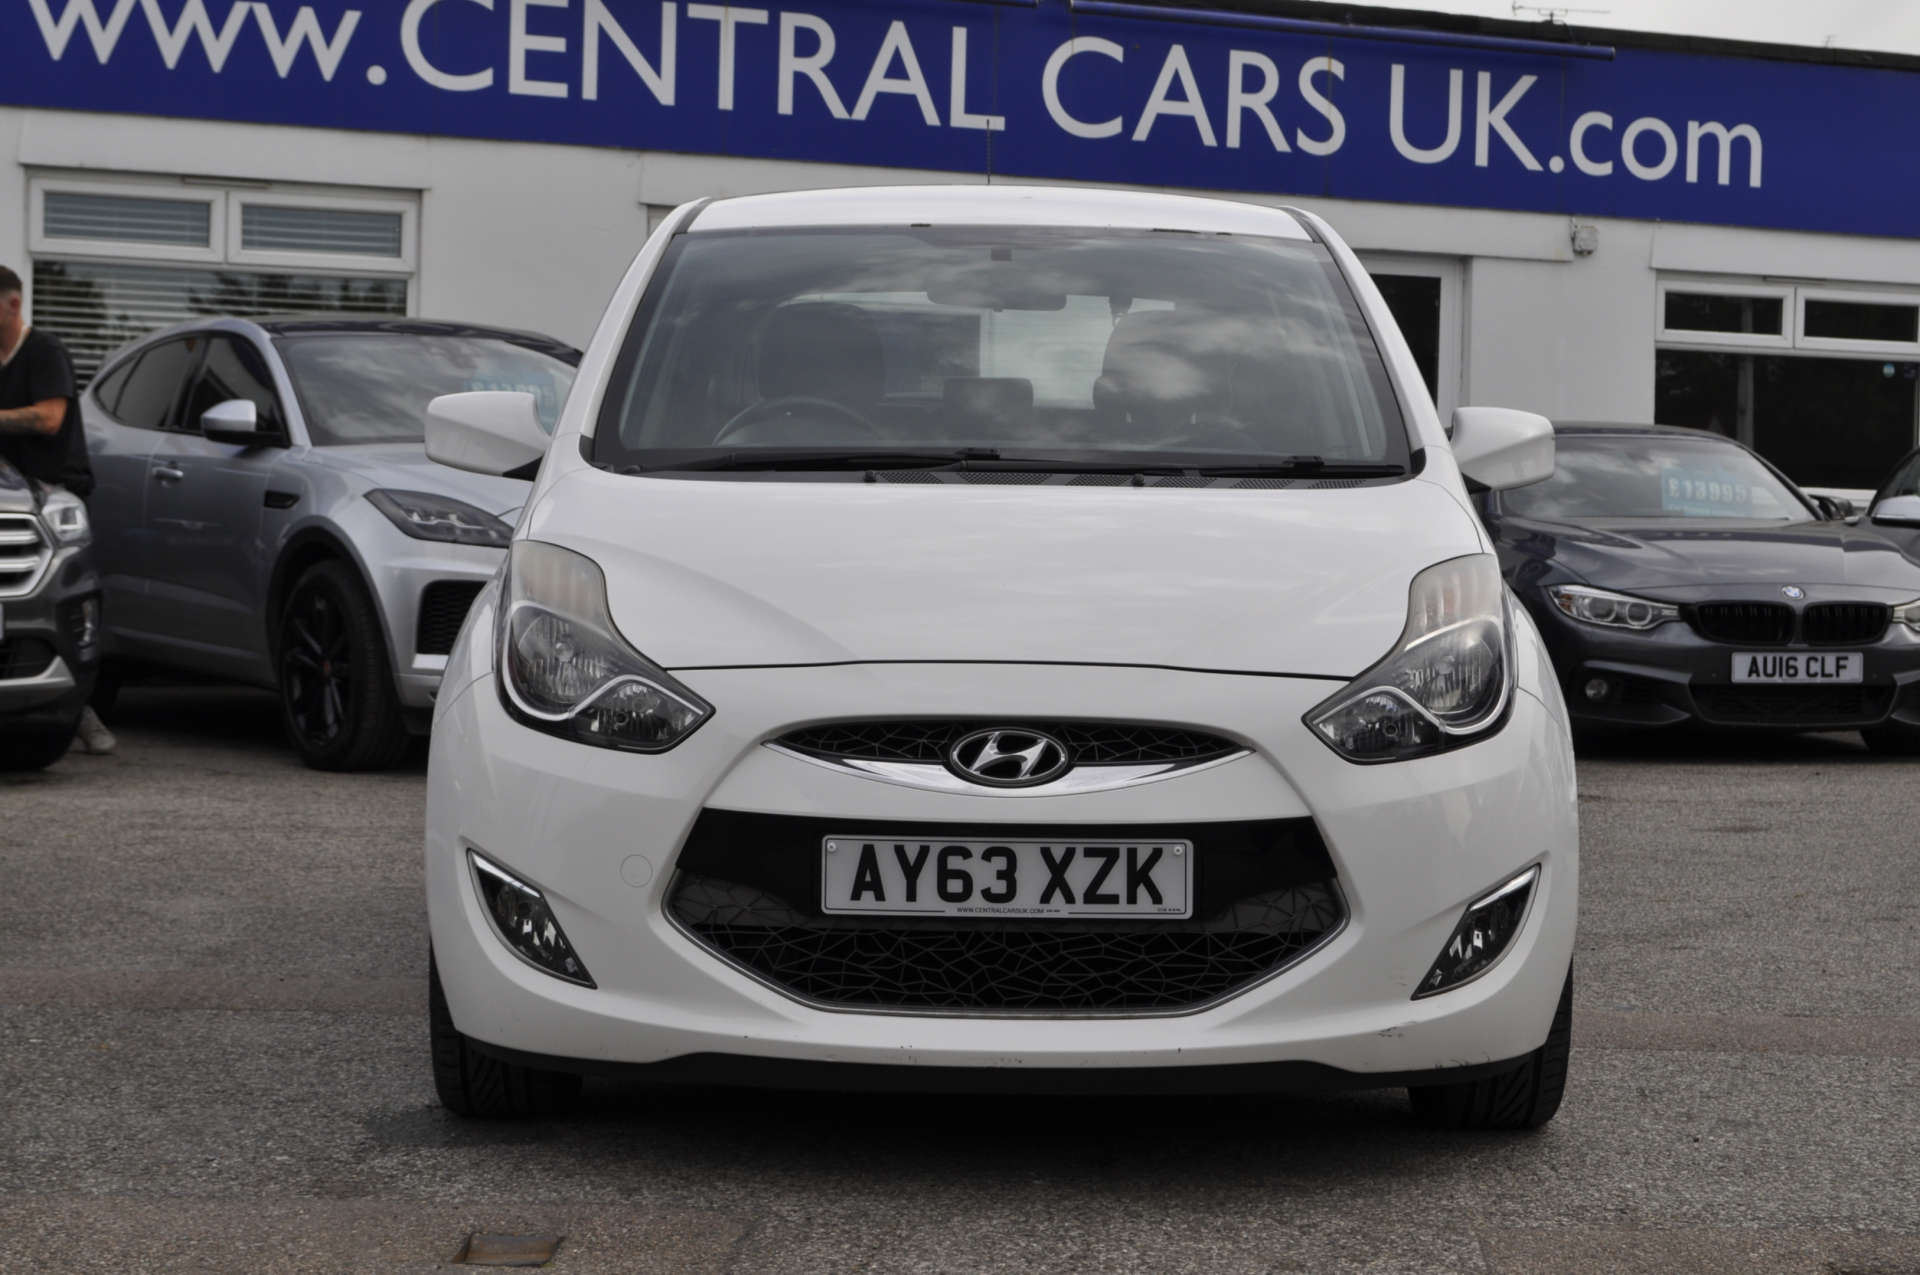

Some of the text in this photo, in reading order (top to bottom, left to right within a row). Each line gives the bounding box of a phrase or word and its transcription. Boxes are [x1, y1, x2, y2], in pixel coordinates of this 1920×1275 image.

[27, 0, 1763, 188] www.CENTRAL CARS UK.com
[1747, 655, 1849, 679] AU16 CLF
[849, 843, 1164, 906] AY63 XZK
